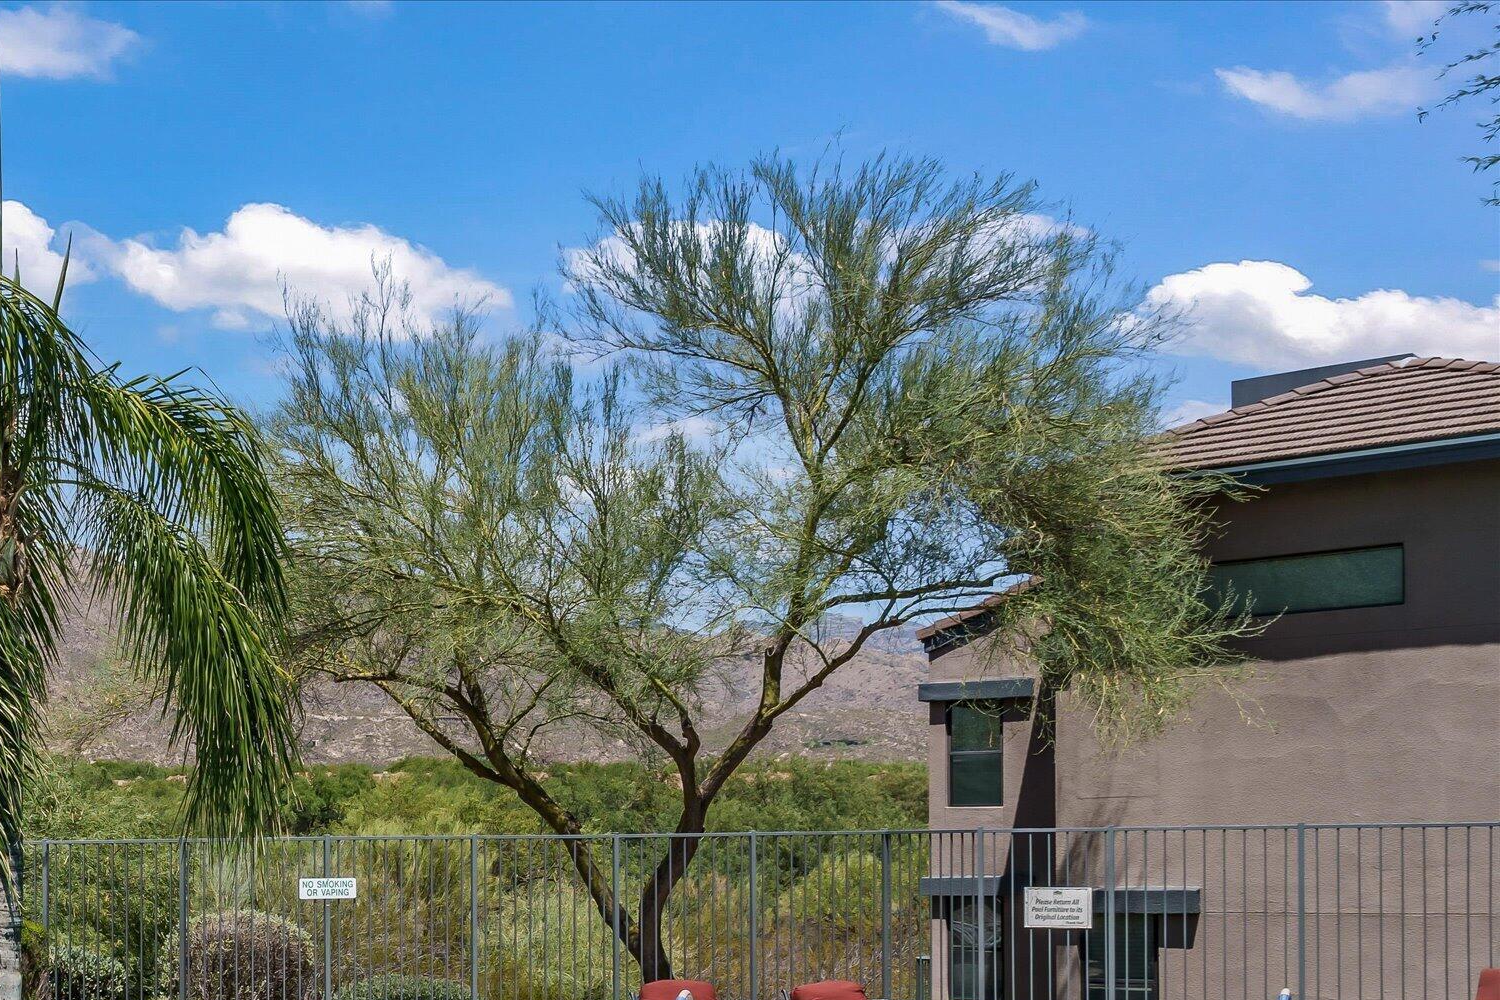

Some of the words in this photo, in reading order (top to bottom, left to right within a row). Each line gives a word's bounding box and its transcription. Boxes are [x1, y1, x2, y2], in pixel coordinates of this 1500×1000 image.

[302, 880, 314, 888] NO
[317, 880, 353, 888] SMOKING
[306, 888, 318, 896] OR
[320, 888, 350, 896] VAPING
